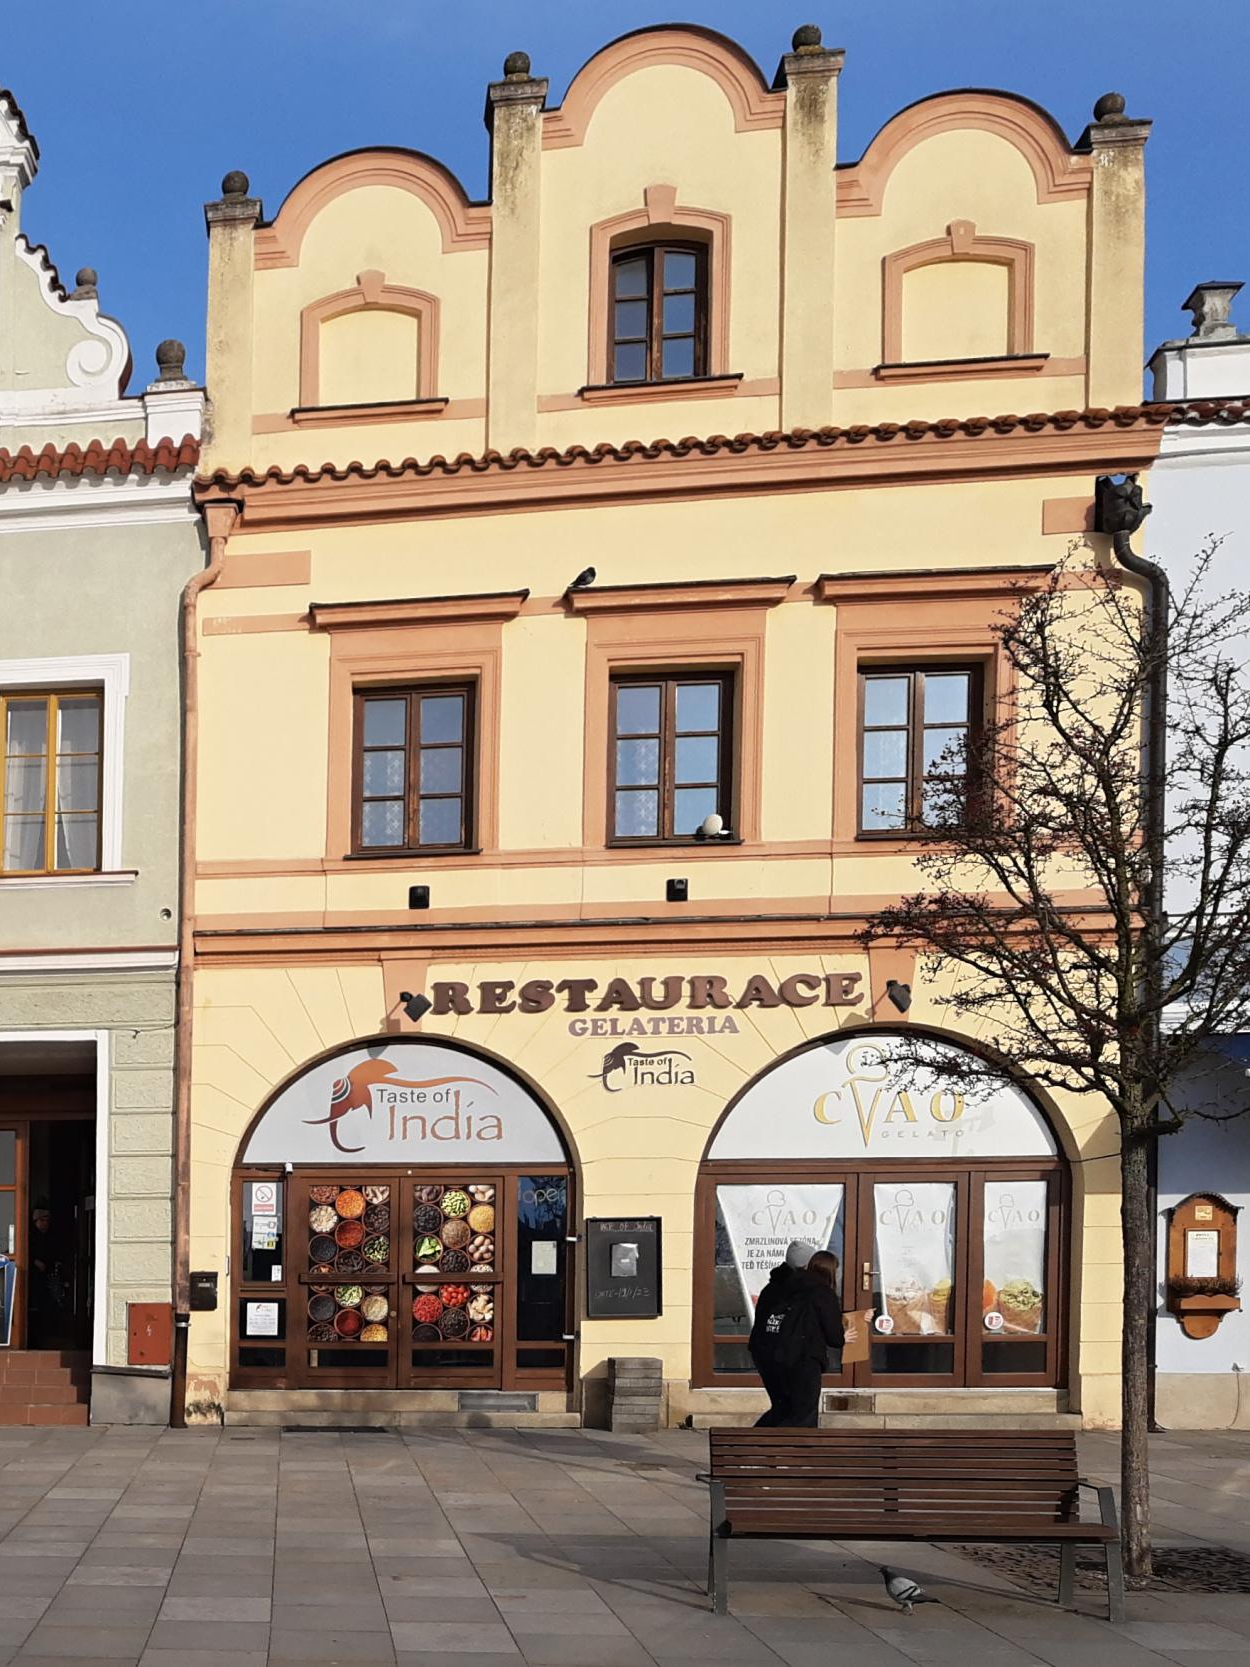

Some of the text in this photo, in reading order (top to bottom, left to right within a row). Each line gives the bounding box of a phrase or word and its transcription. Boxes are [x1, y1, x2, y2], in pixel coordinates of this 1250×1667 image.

[430, 972, 865, 1015] RESTAURACE
[568, 1016, 740, 1037] GELATERIA
[627, 1057, 668, 1066] Taste of
[634, 1058, 695, 1086] India
[376, 1088, 452, 1104] Taste of
[388, 1090, 503, 1141] India
[881, 1129, 965, 1139] GELATO
